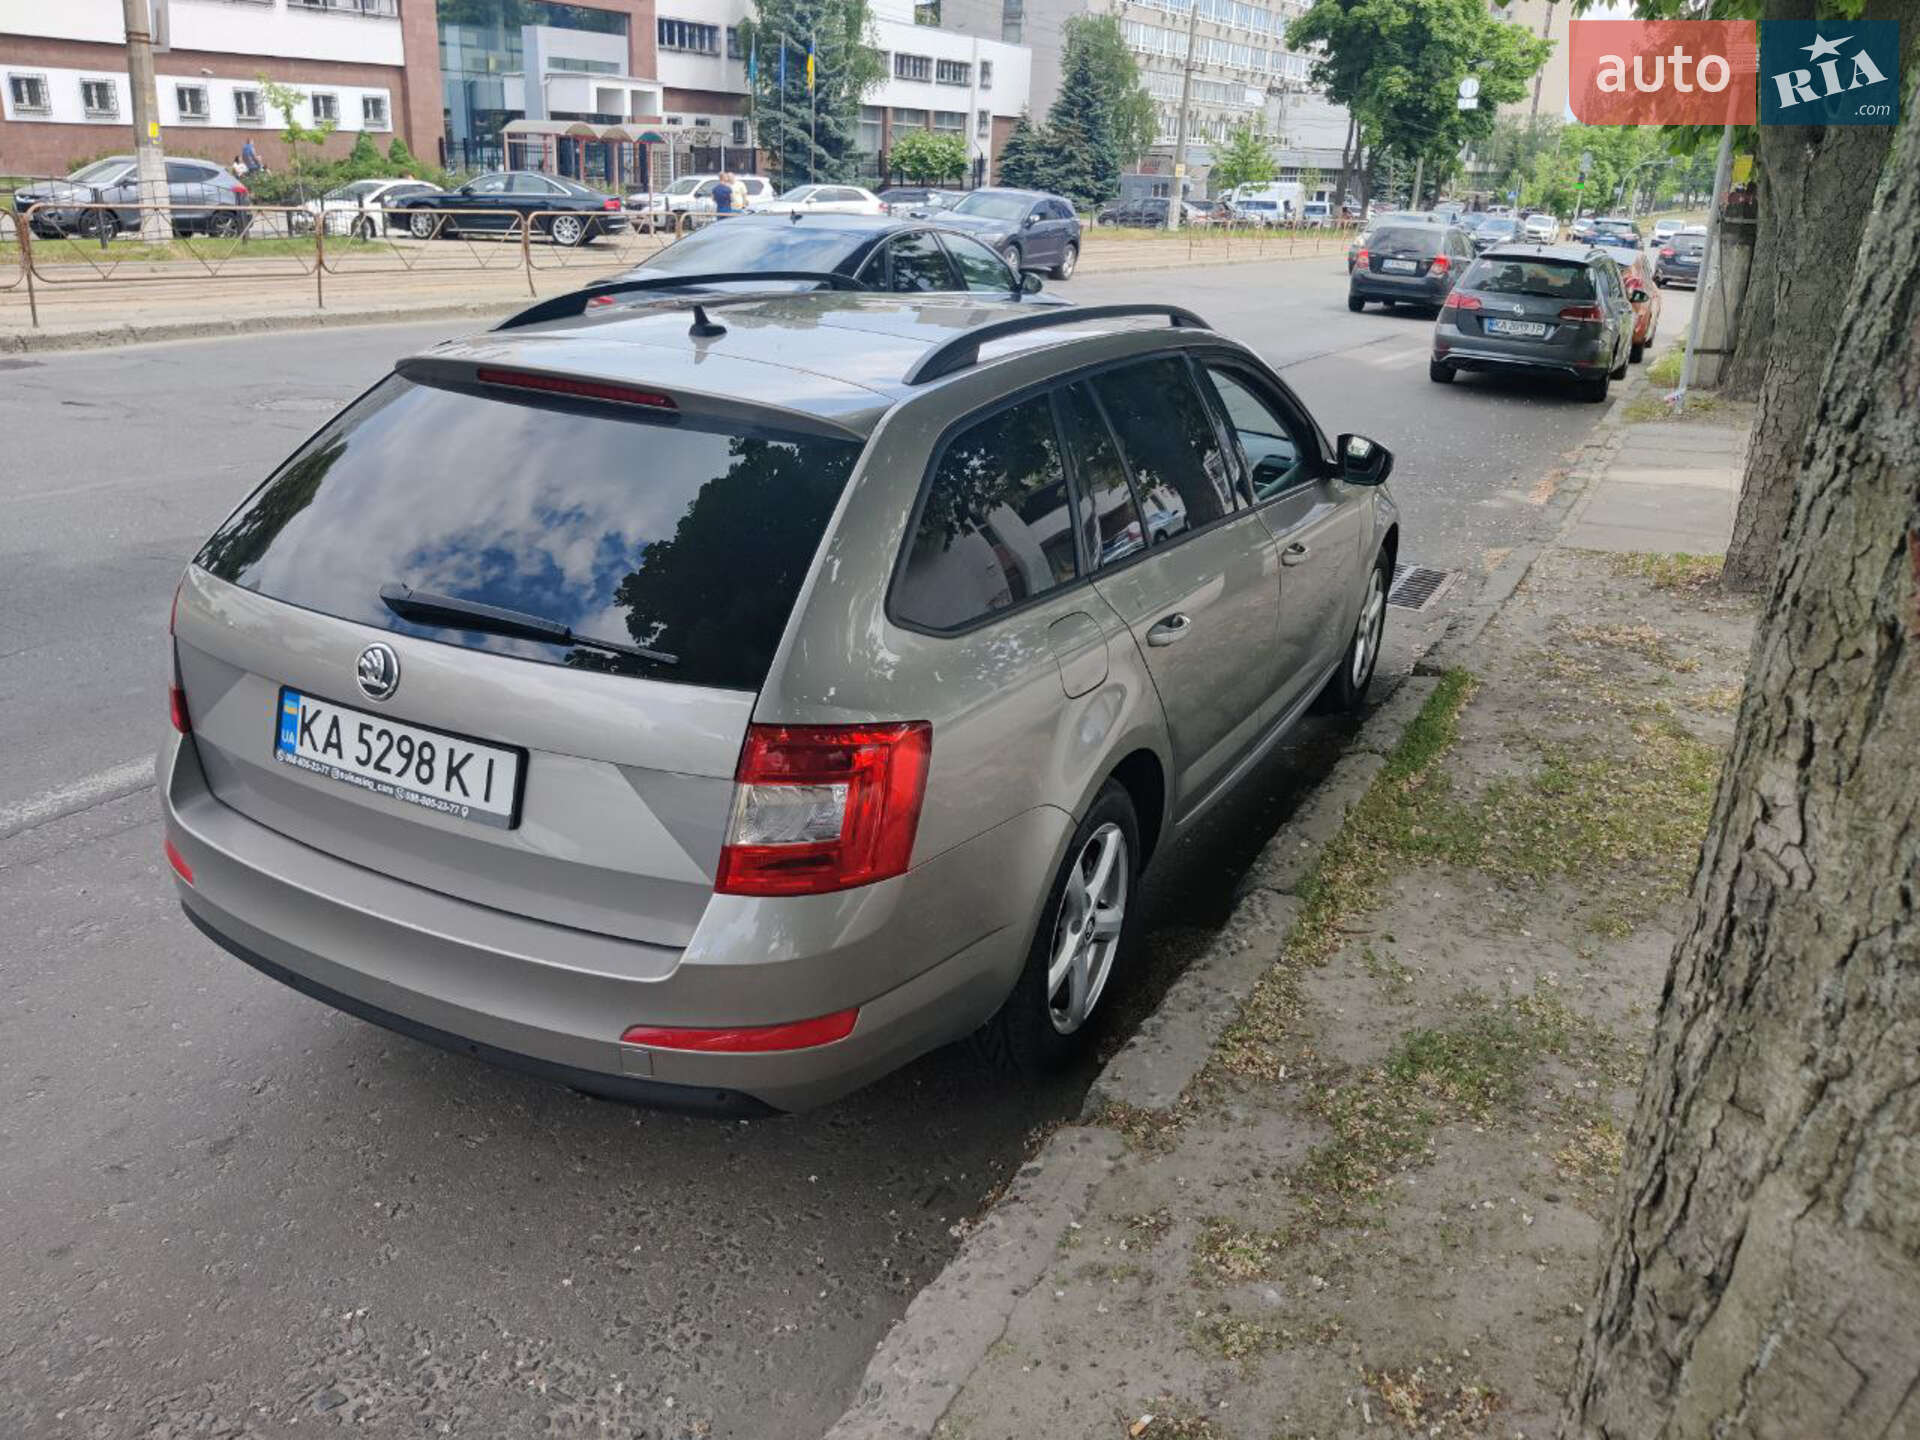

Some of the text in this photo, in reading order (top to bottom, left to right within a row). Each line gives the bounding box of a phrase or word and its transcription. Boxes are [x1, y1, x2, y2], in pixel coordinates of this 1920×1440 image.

[281, 730, 295, 745] UA
[299, 704, 344, 760] KA
[355, 722, 436, 785] 5298
[445, 747, 495, 803] KI
